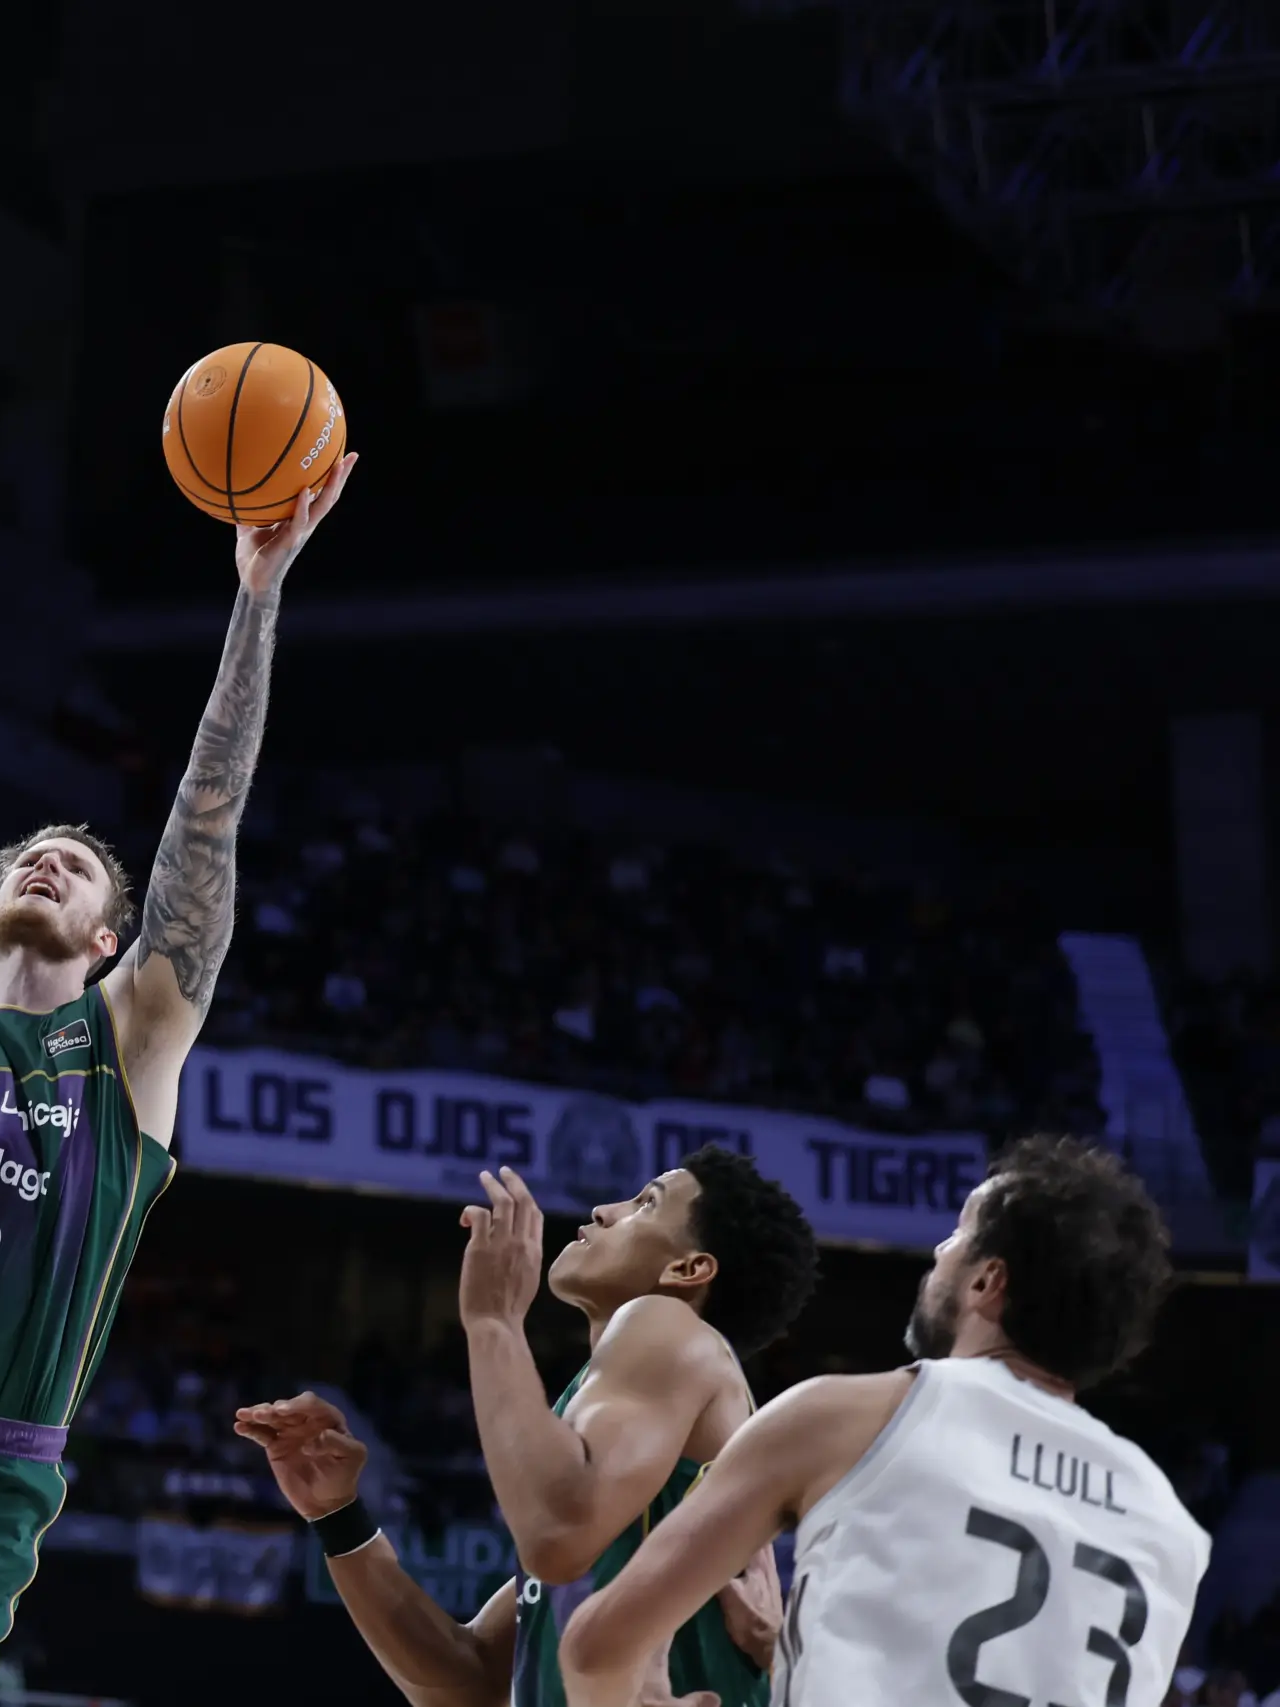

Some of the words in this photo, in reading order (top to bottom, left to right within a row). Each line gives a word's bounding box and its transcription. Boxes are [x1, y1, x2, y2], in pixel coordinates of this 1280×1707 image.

[300, 405, 336, 469] endesa
[49, 1035, 87, 1053] endesa
[204, 1066, 332, 1143] LOS
[375, 1089, 532, 1166] OJOS
[808, 1138, 978, 1213] TIGRE
[1010, 1434, 1127, 1515] LLULL
[946, 1505, 1149, 1707] 23
